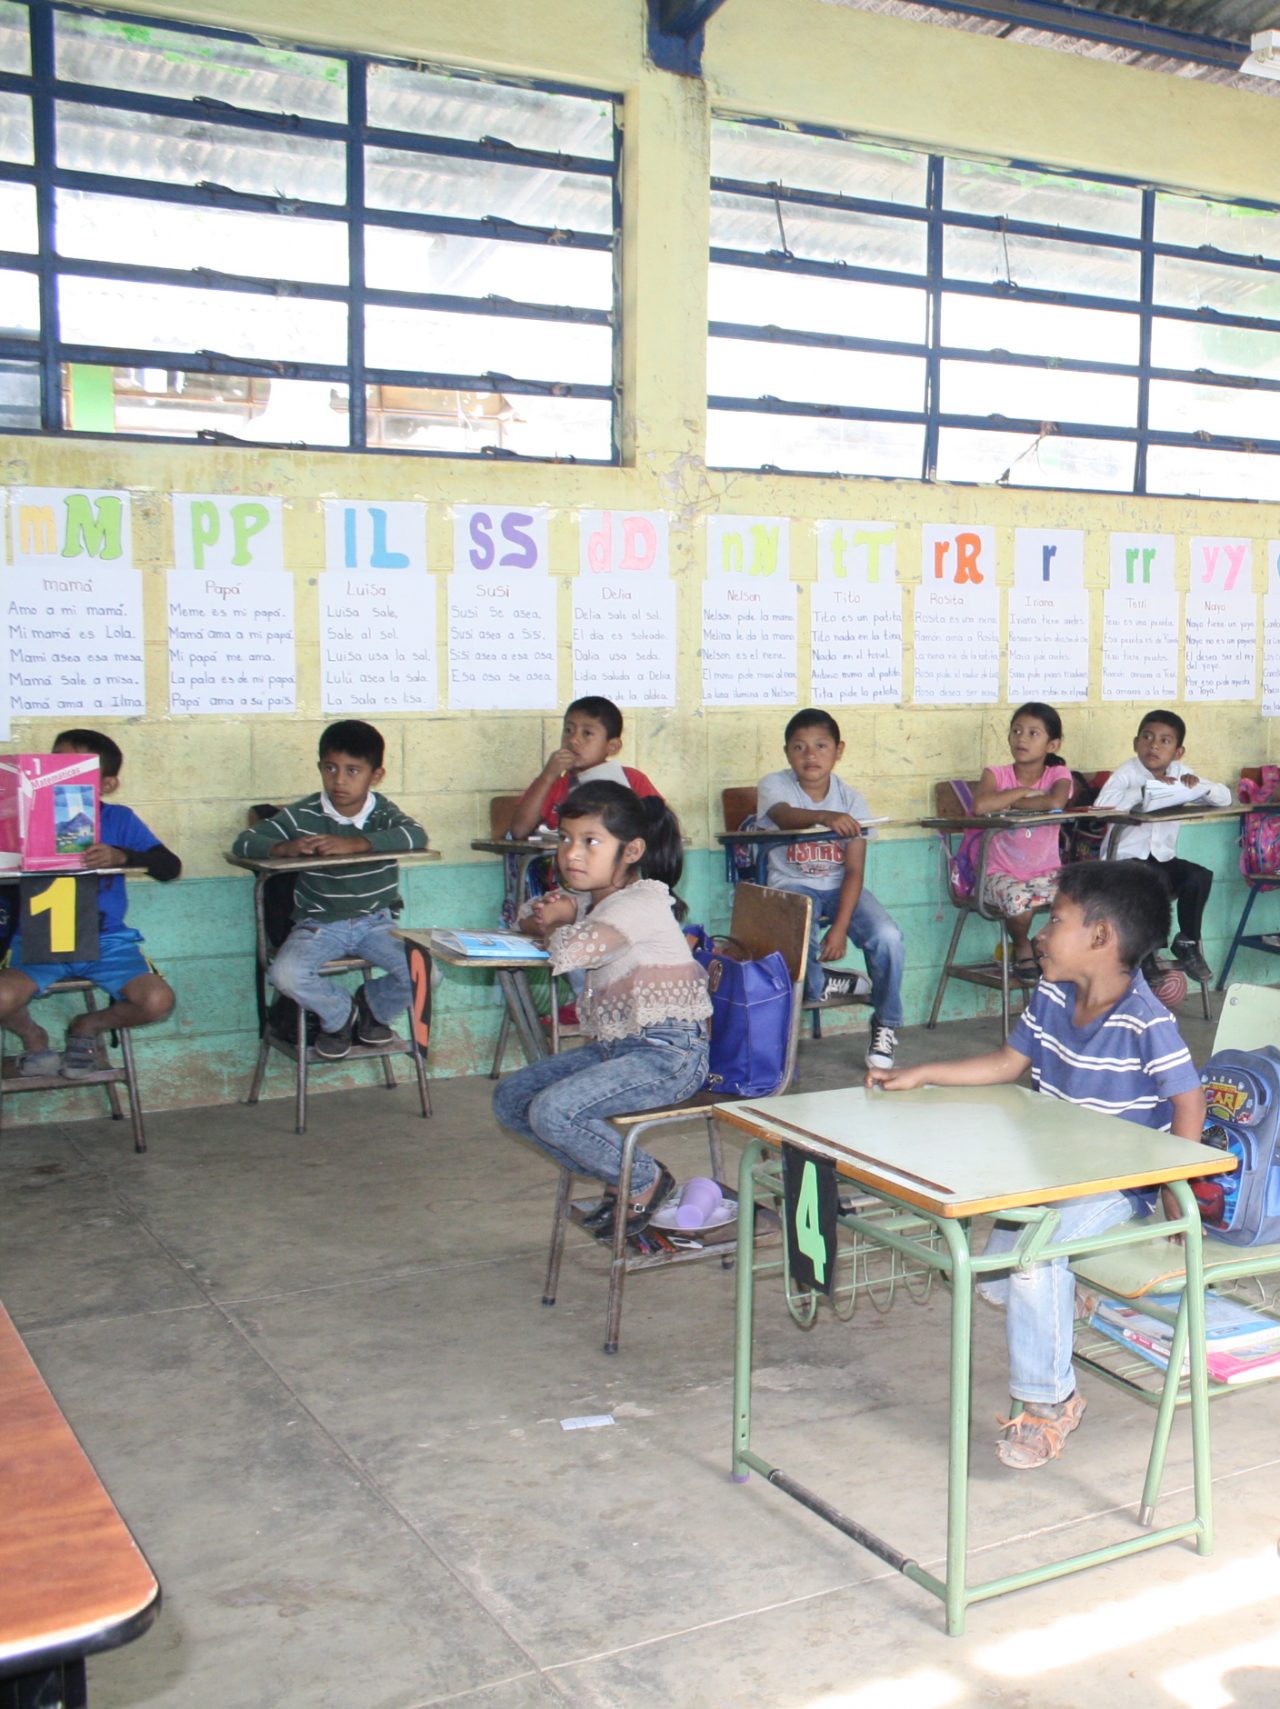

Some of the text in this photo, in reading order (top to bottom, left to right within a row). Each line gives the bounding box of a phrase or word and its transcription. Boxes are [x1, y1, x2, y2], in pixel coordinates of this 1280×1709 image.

[587, 511, 657, 573] dD
[722, 524, 779, 578] nN
[830, 527, 896, 583] tT
[934, 532, 985, 585] rR
[602, 587, 632, 600] Delia
[834, 592, 861, 603] Tito
[30, 877, 77, 953] 1
[796, 1160, 827, 1285] 4
